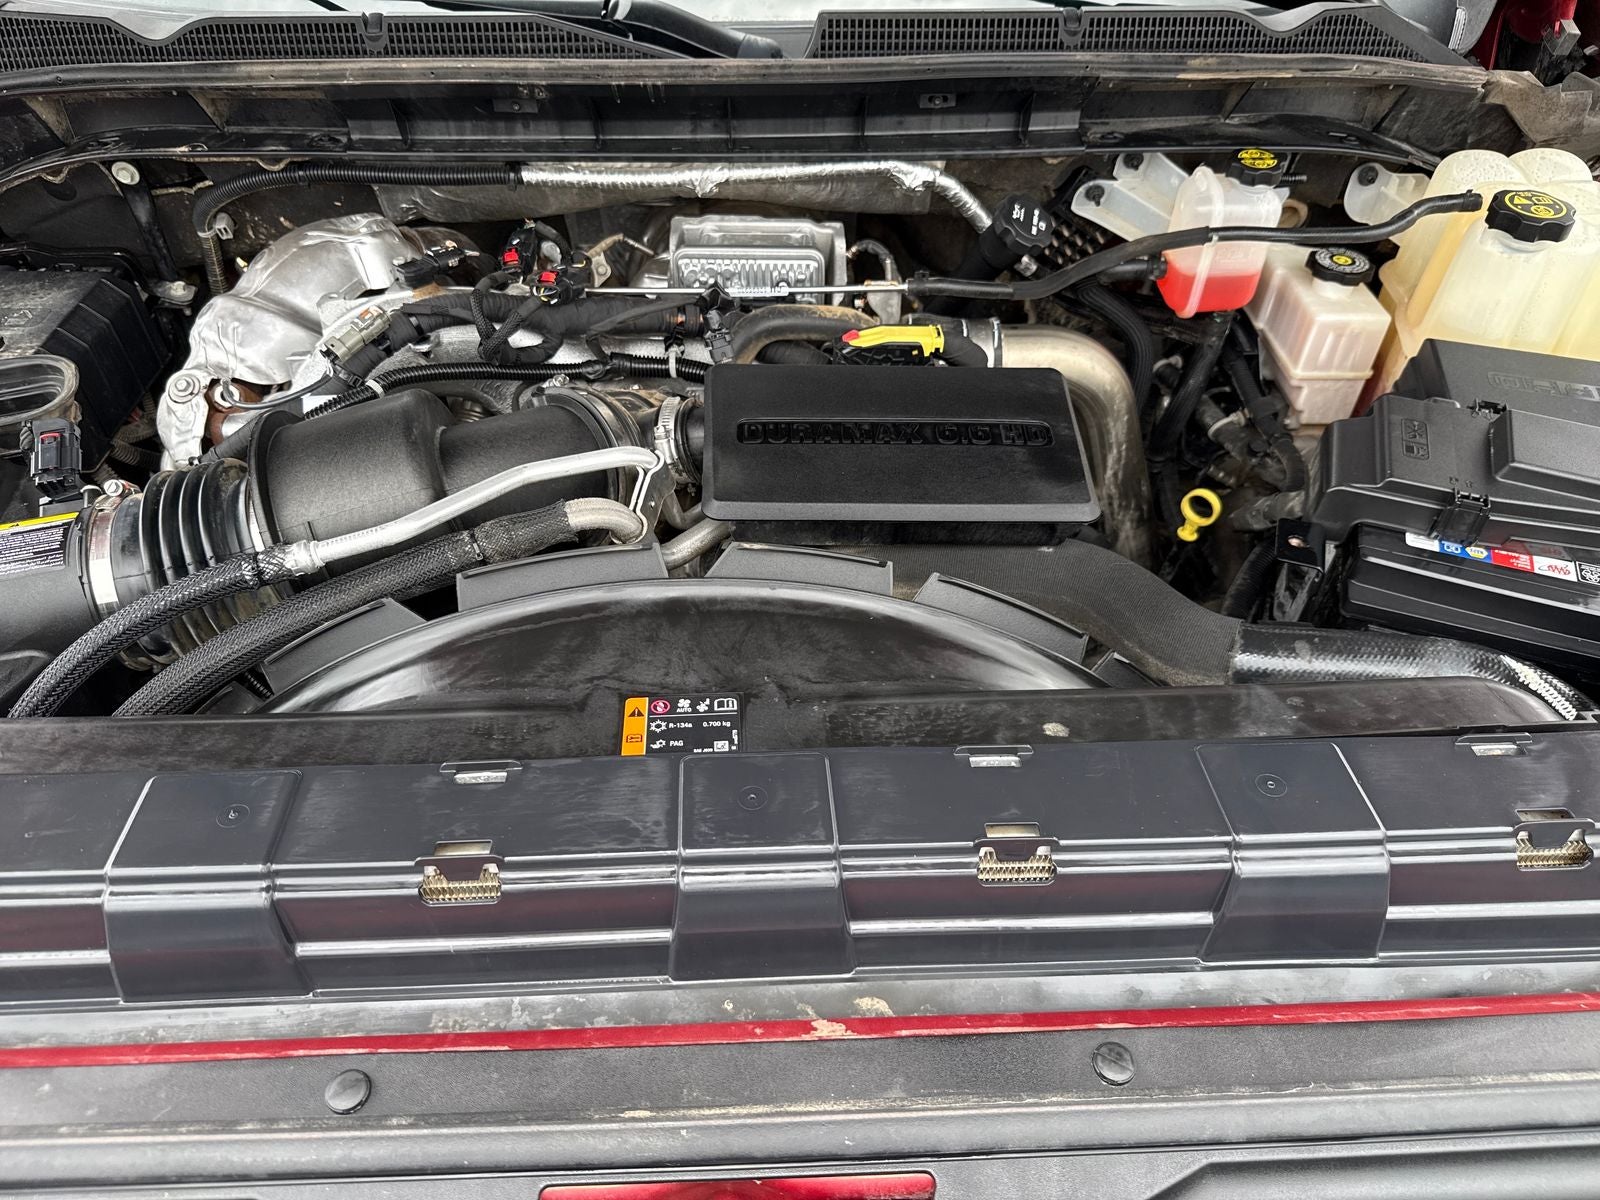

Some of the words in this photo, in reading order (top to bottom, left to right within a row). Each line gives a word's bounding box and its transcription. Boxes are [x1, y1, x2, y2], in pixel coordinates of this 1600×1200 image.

[743, 422, 923, 444] DURAMAX
[935, 424, 992, 445] 6.6
[1000, 424, 1048, 446] HD
[722, 720, 731, 728] kg
